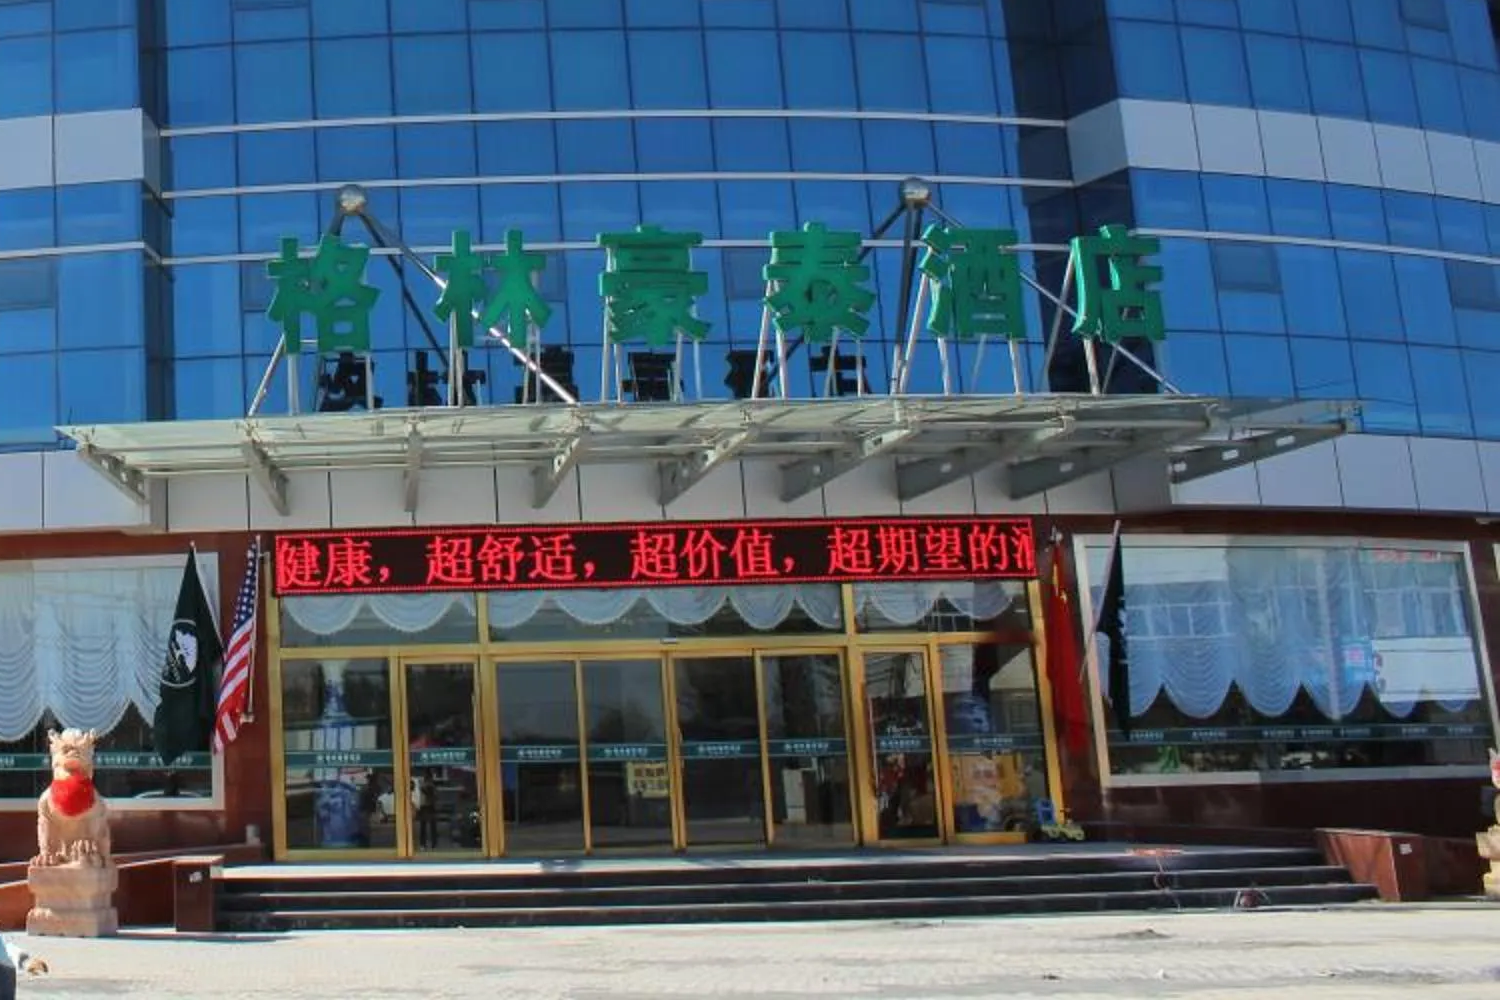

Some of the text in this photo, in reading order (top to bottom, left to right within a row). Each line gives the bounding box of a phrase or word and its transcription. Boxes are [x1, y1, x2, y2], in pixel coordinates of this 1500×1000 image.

[266, 221, 1166, 355] 格林豪泰酒店
